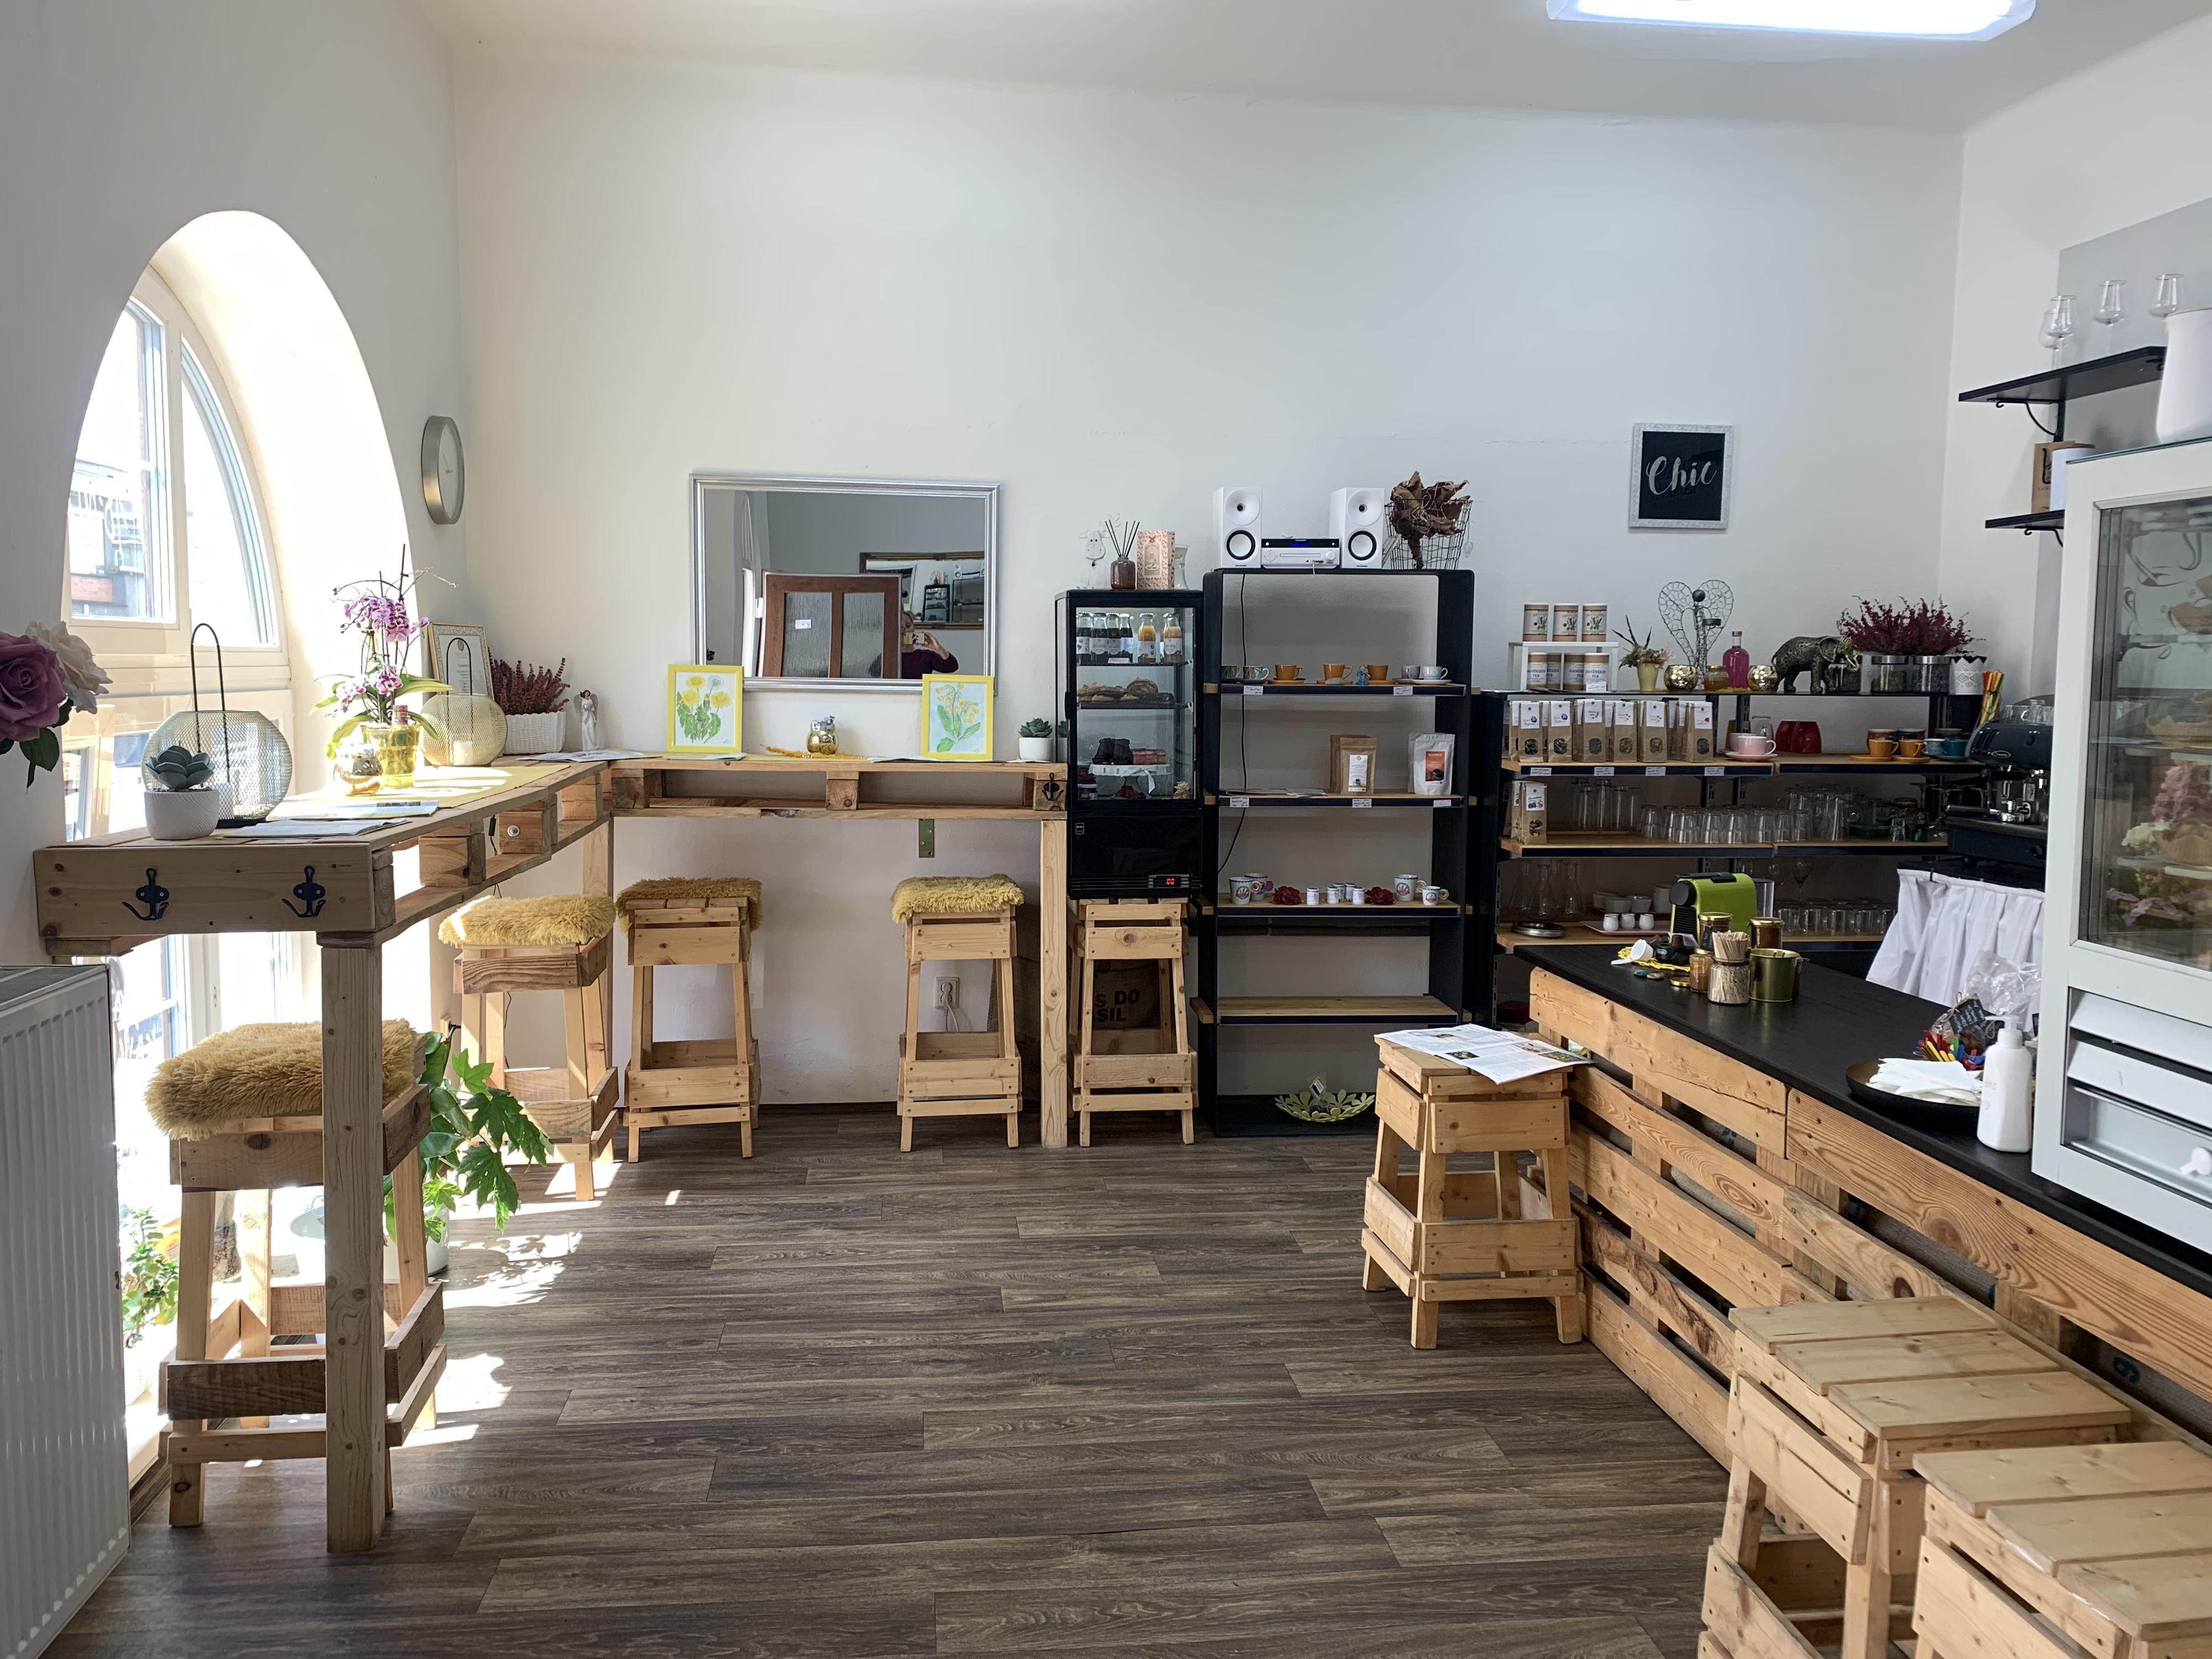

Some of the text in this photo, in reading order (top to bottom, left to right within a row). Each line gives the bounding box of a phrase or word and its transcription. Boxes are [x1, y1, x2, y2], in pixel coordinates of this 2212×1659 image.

[1646, 456, 1718, 495] Chic
[1114, 989, 1140, 1005] DO
[1096, 1008, 1127, 1022] SIL
